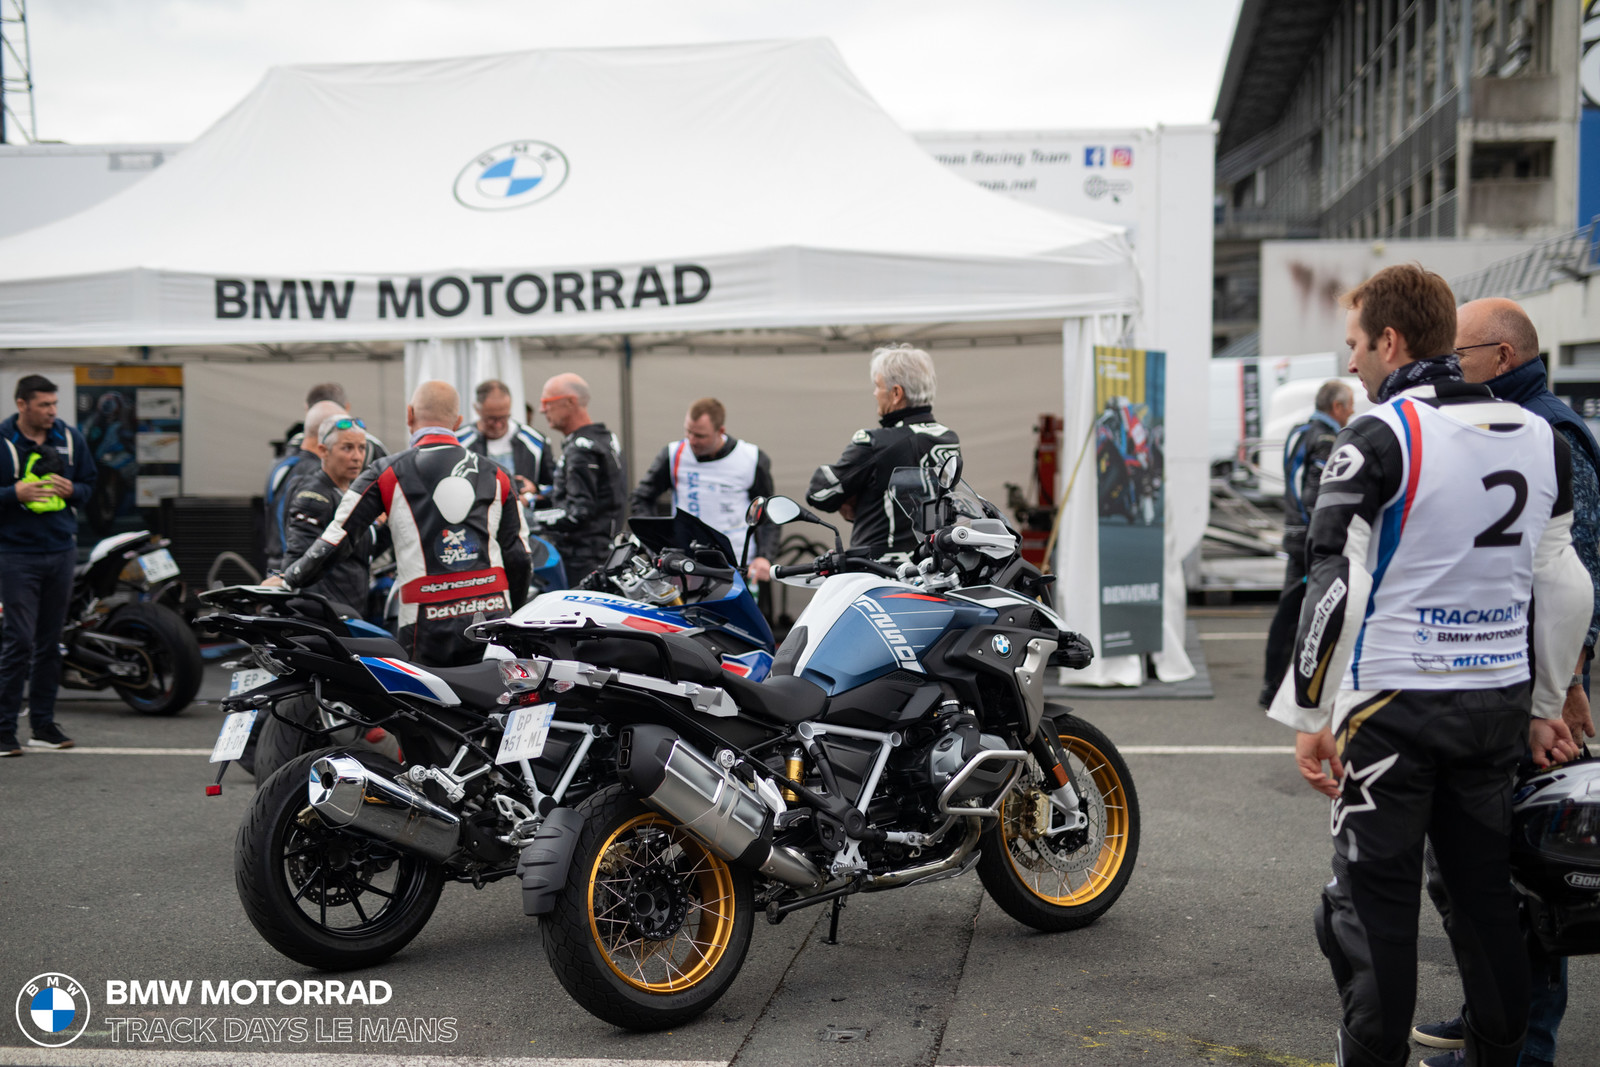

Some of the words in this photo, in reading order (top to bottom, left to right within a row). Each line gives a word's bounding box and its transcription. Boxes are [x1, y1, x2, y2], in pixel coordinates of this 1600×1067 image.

[971, 149, 1026, 167] Racing
[1030, 148, 1072, 164] Team
[214, 278, 355, 320] BMW
[377, 264, 712, 319] MOTORRAD
[687, 472, 699, 517] DAYS
[1474, 470, 1528, 548] 2
[420, 574, 497, 593] alpinestars
[1301, 580, 1345, 676] alpinestars
[1437, 631, 1473, 642] BMW
[1571, 874, 1600, 887] HOEI
